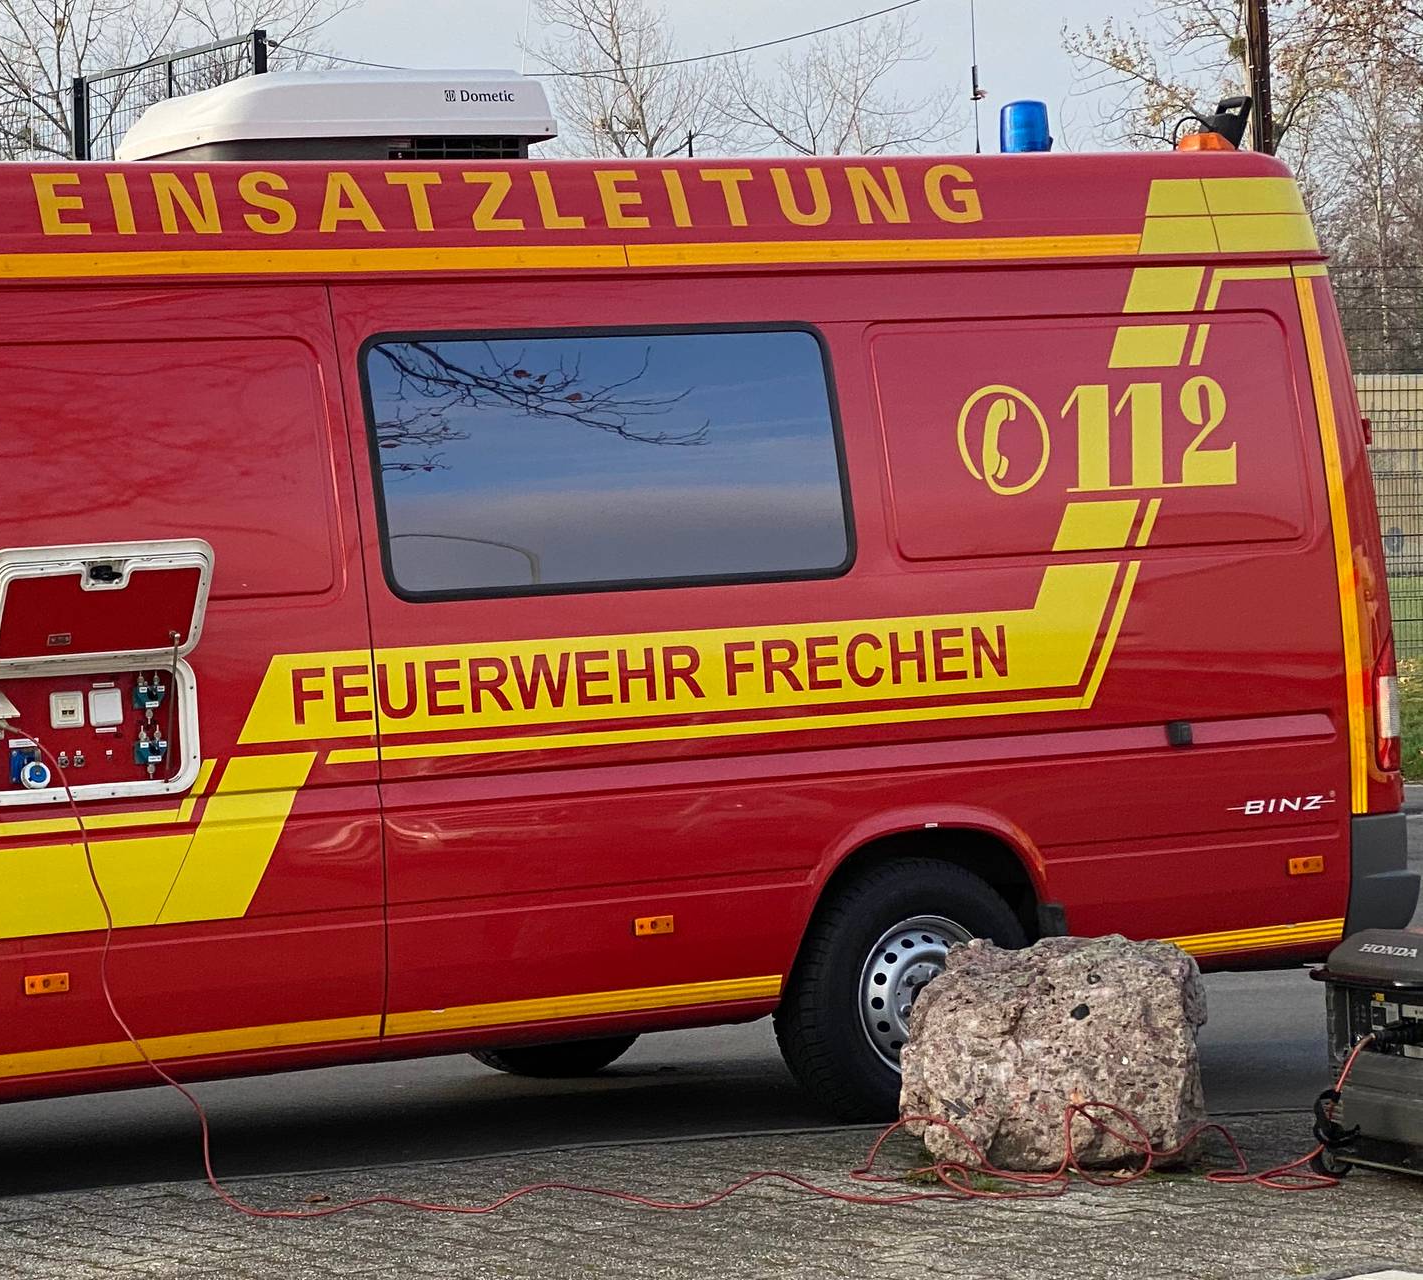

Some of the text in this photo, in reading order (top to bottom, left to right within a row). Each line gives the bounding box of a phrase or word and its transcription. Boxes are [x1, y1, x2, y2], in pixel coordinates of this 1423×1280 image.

[460, 90, 515, 102] Dometic
[30, 164, 984, 235] EINSATZLEITUNG
[1060, 375, 1238, 493] 112
[290, 624, 1010, 726] FEUERWEHR FRECHEN
[1244, 795, 1324, 815] BINZ
[1358, 943, 1418, 958] HONDA
